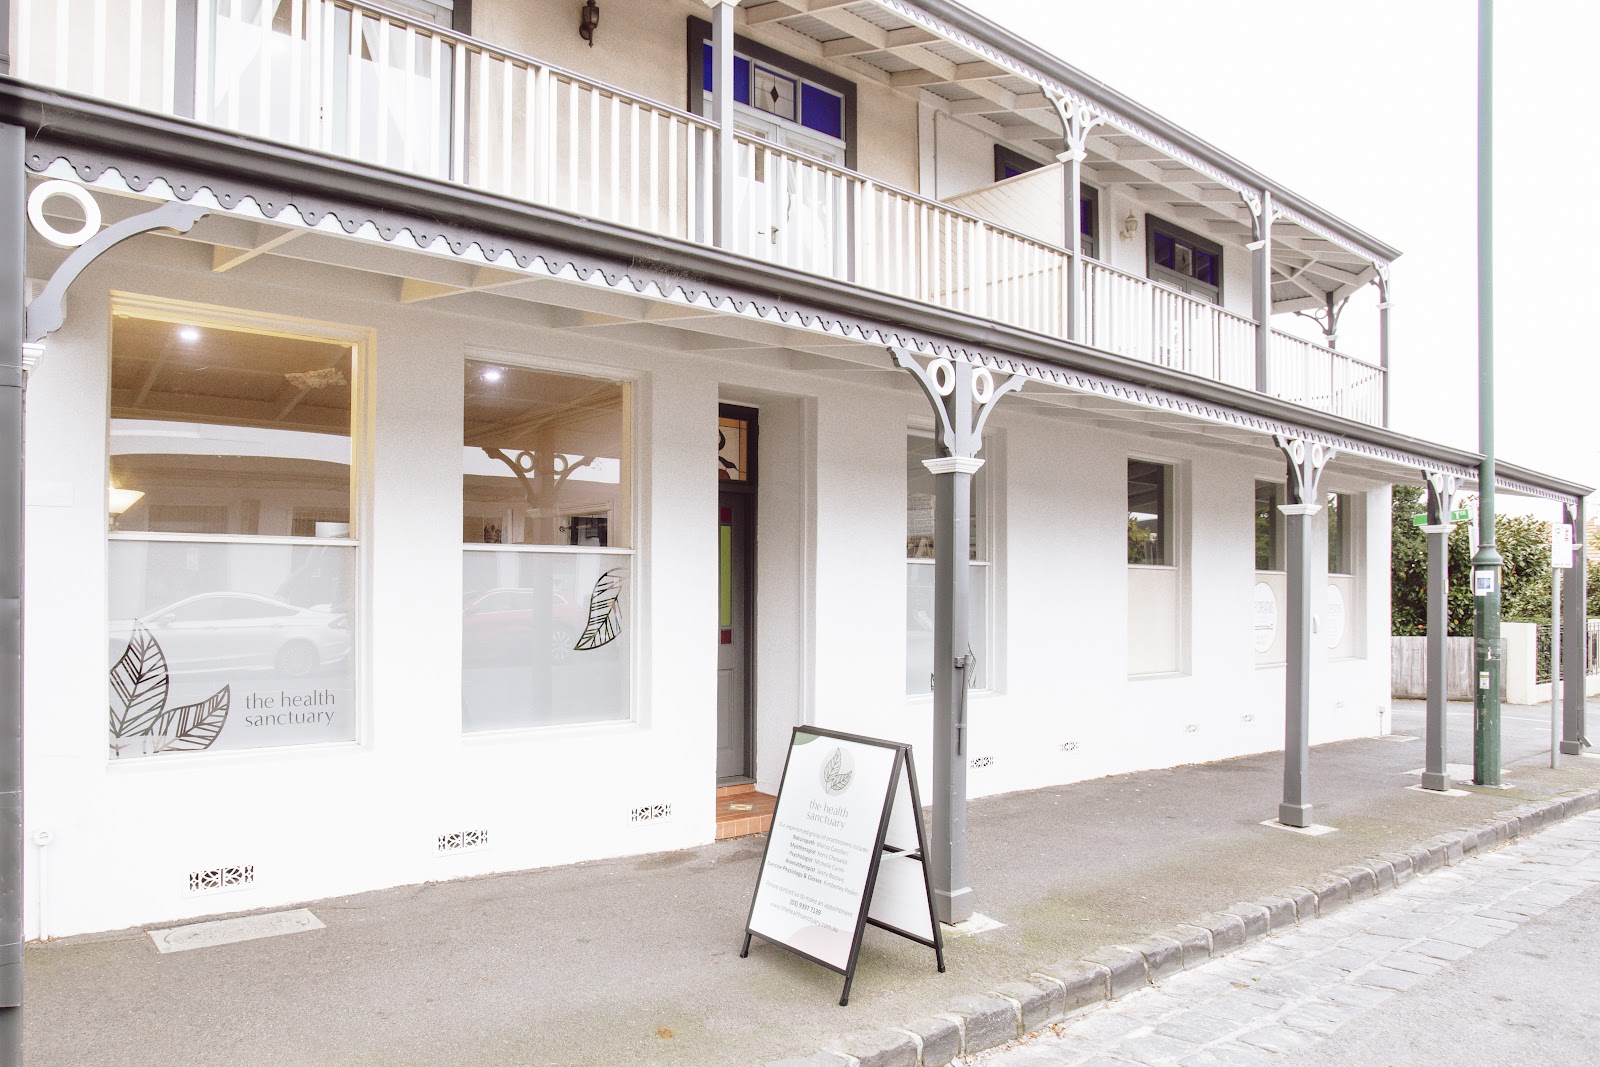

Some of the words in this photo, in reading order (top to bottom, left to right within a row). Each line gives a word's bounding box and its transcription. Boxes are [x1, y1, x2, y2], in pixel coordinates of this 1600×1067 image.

[245, 692, 275, 710] the
[281, 688, 335, 708] health
[245, 710, 335, 728] sanctuary
[809, 798, 822, 811] the
[823, 802, 849, 818] health
[807, 812, 846, 830] sanctuary
[786, 825, 809, 835] experienced
[826, 836, 852, 848] practitioners
[793, 834, 815, 845] Naturopath
[790, 842, 816, 855] Myotherapist
[785, 858, 816, 872] Aromatherapist
[789, 850, 813, 863] Psychologist
[814, 859, 831, 869] Michelle
[767, 860, 782, 870] Exercise
[782, 865, 803, 878] Physiology
[807, 874, 822, 884] Classes
[823, 880, 844, 892] Kimberley
[766, 880, 778, 890] Please
[778, 886, 794, 895] contact
[805, 896, 817, 904] make
[824, 904, 853, 918] appointment
[789, 898, 799, 908] (03)
